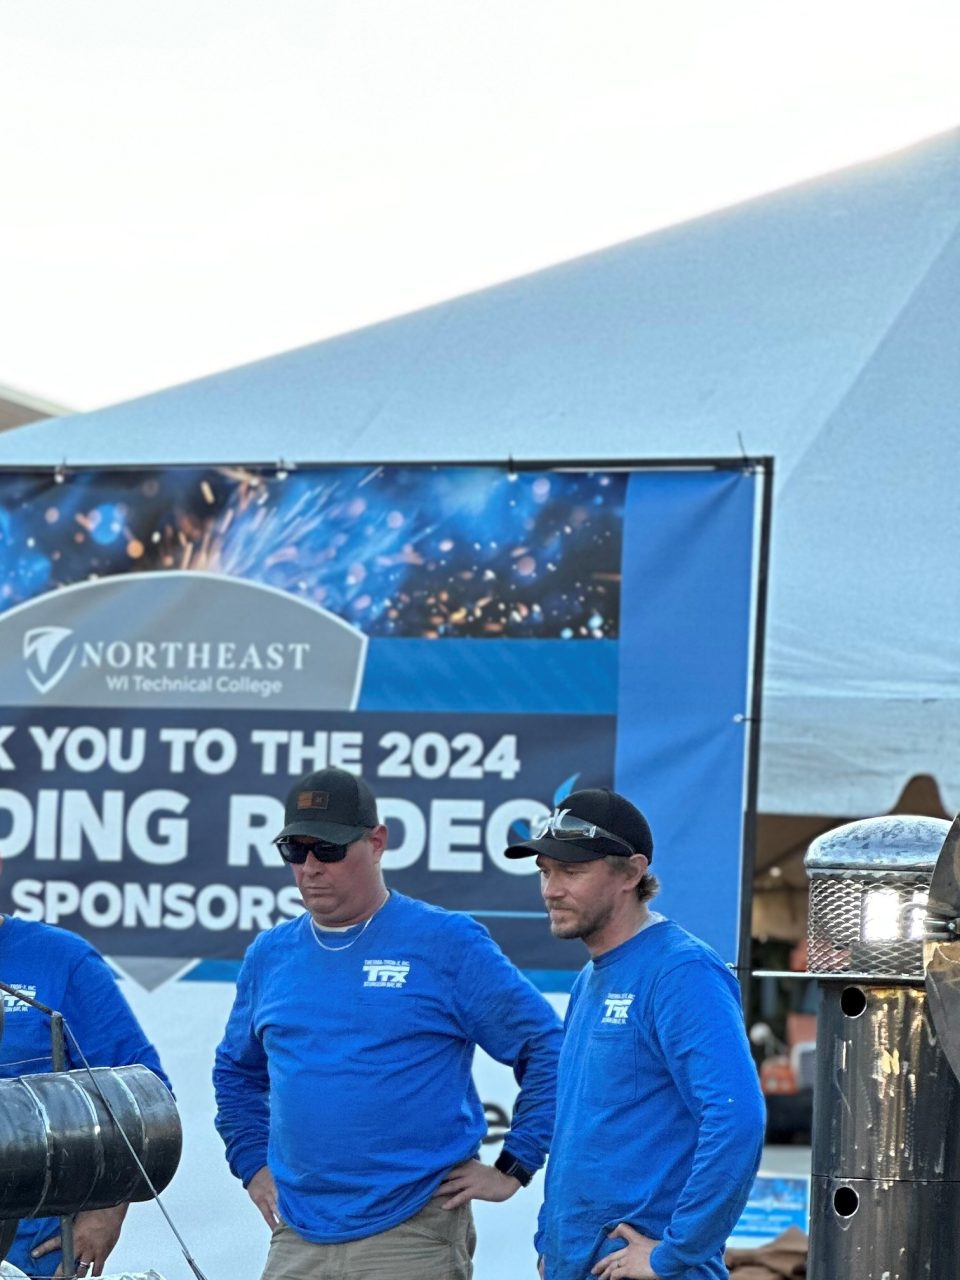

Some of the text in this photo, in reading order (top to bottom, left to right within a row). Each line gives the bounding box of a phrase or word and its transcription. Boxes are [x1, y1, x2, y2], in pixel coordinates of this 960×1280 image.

[80, 640, 311, 670] NORTHEAST
[106, 675, 283, 698] WI Technical College
[29, 726, 146, 773] YOU
[159, 728, 237, 775] TO
[251, 730, 364, 776] THE
[377, 731, 521, 780] 2024
[227, 794, 552, 876] RDEO
